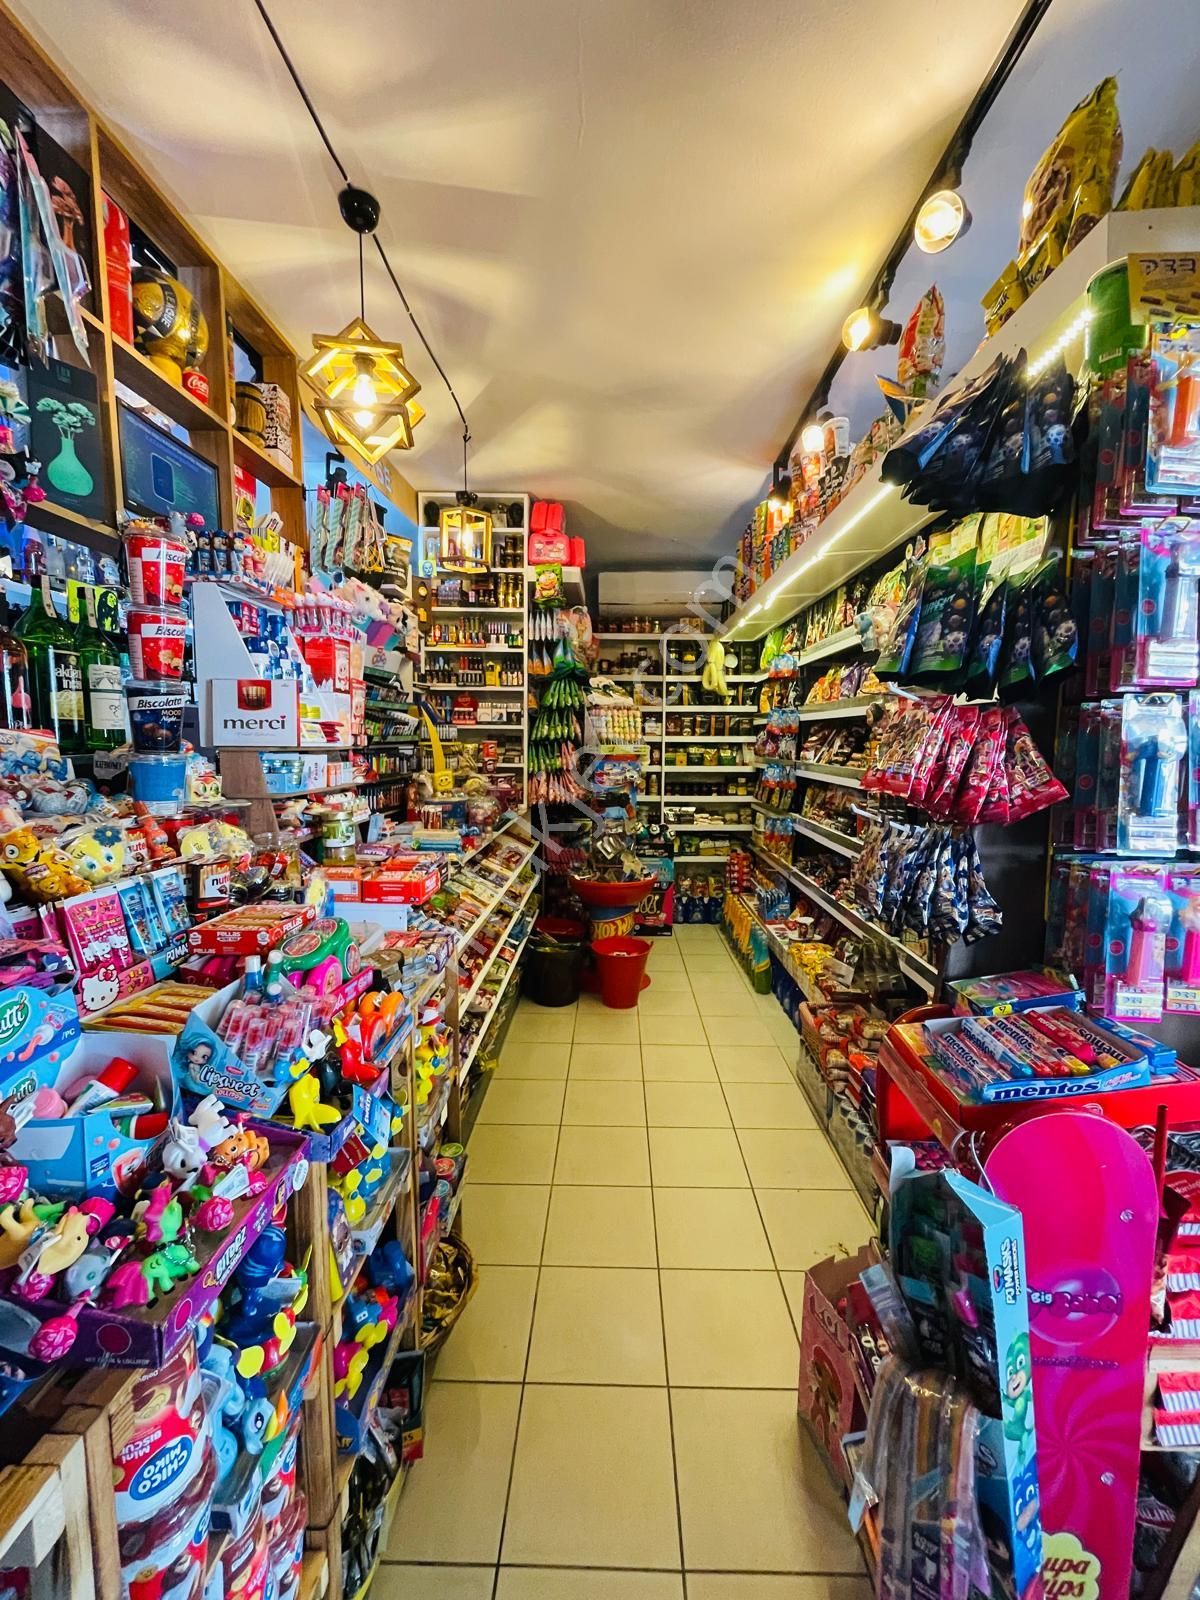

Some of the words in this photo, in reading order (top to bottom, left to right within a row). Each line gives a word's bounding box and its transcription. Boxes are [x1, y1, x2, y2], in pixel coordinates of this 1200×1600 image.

[223, 715, 287, 730] merci
[993, 1080, 1100, 1100] mentos
[1000, 1237, 1016, 1286] MASKS
[1005, 1286, 1016, 1305] PJ
[1031, 1292, 1053, 1304] Big
[142, 1442, 182, 1477] MIKO
[137, 1450, 188, 1494] CHICO
